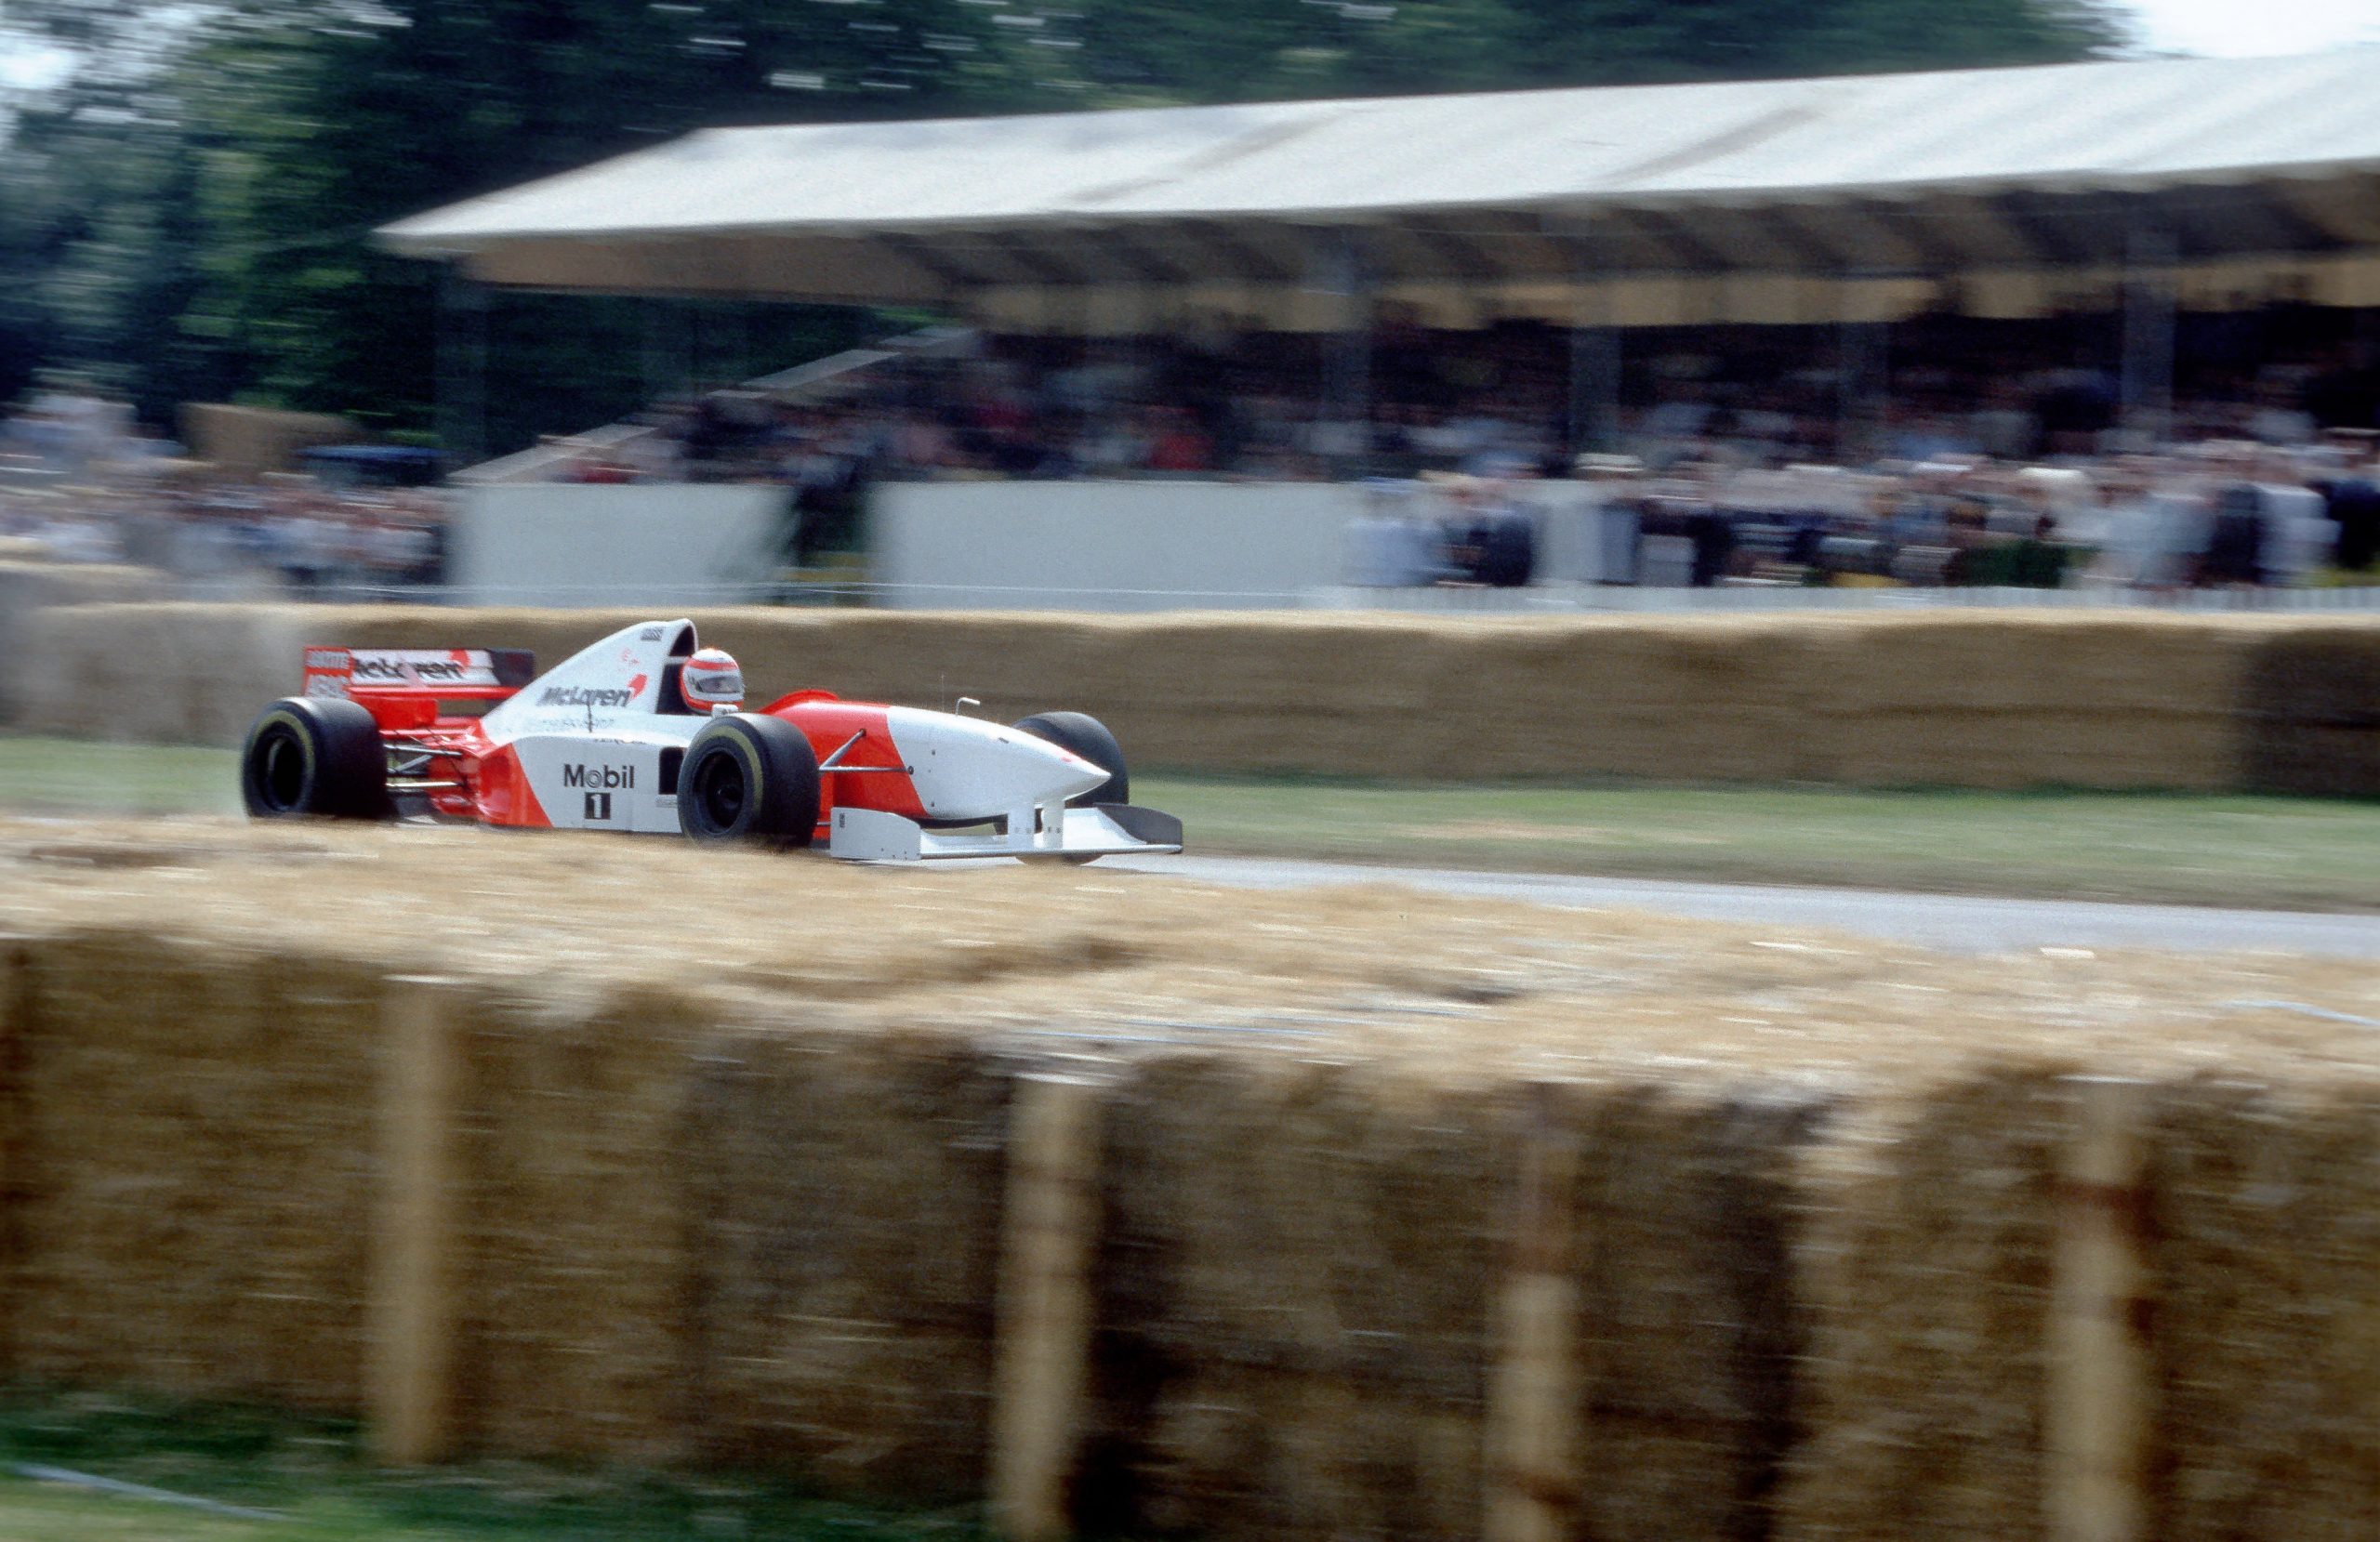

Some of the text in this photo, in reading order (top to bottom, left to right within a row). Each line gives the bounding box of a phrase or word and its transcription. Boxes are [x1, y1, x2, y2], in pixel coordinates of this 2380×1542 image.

[536, 686, 631, 707] McLaren
[563, 763, 635, 789] Mobil
[589, 793, 603, 819] 1
